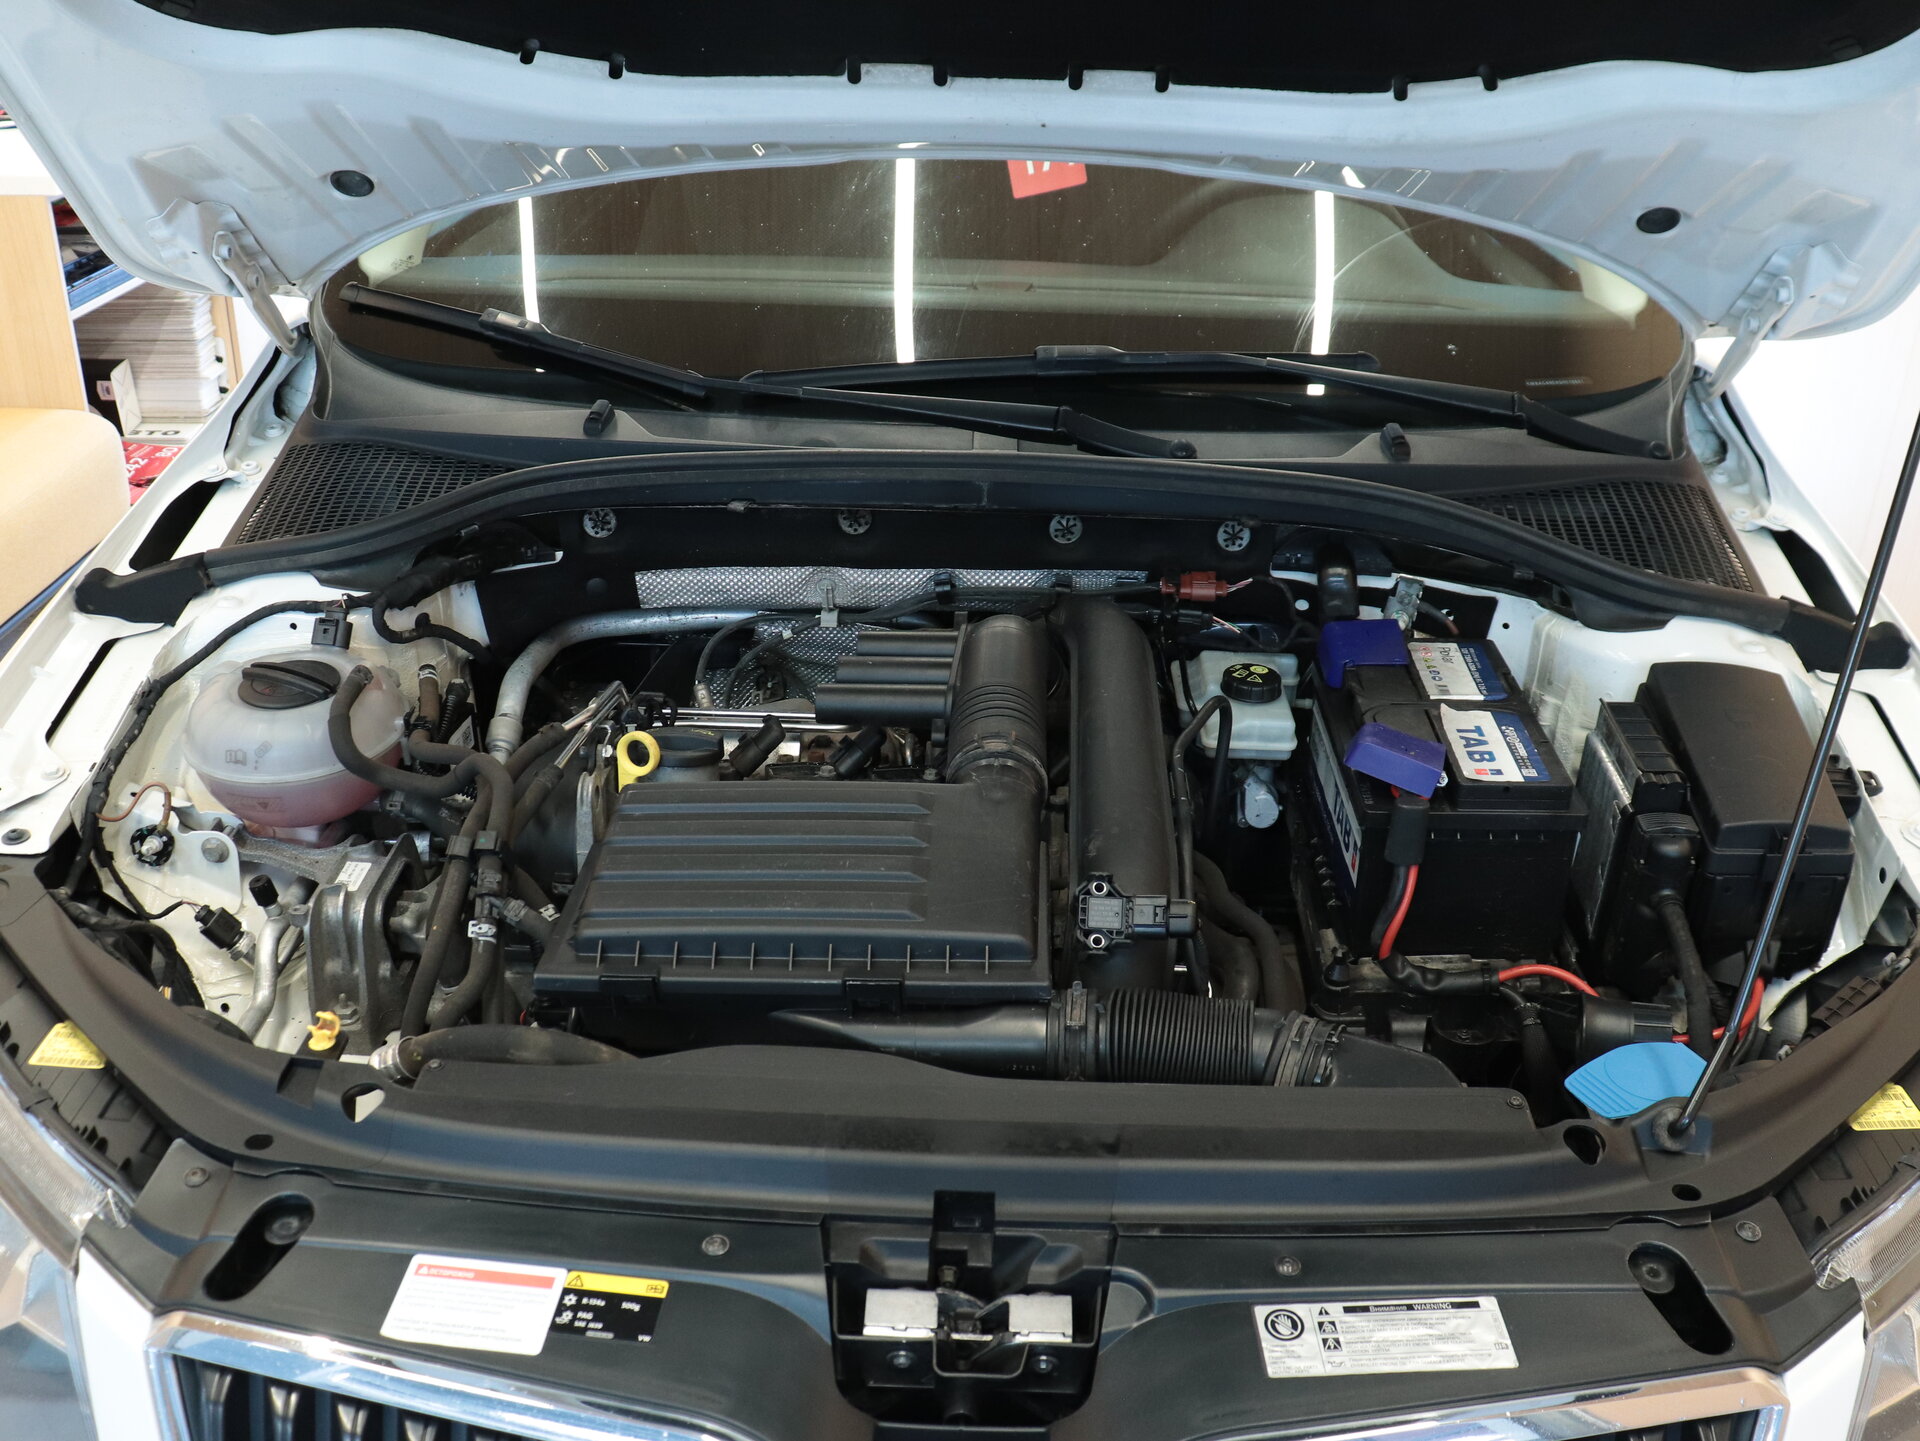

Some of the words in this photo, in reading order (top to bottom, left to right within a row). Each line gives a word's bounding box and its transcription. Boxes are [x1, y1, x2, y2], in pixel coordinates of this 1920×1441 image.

[1438, 646, 1454, 664] Polar
[1456, 725, 1497, 763] TAB
[1412, 1302, 1452, 1311] WARNING
